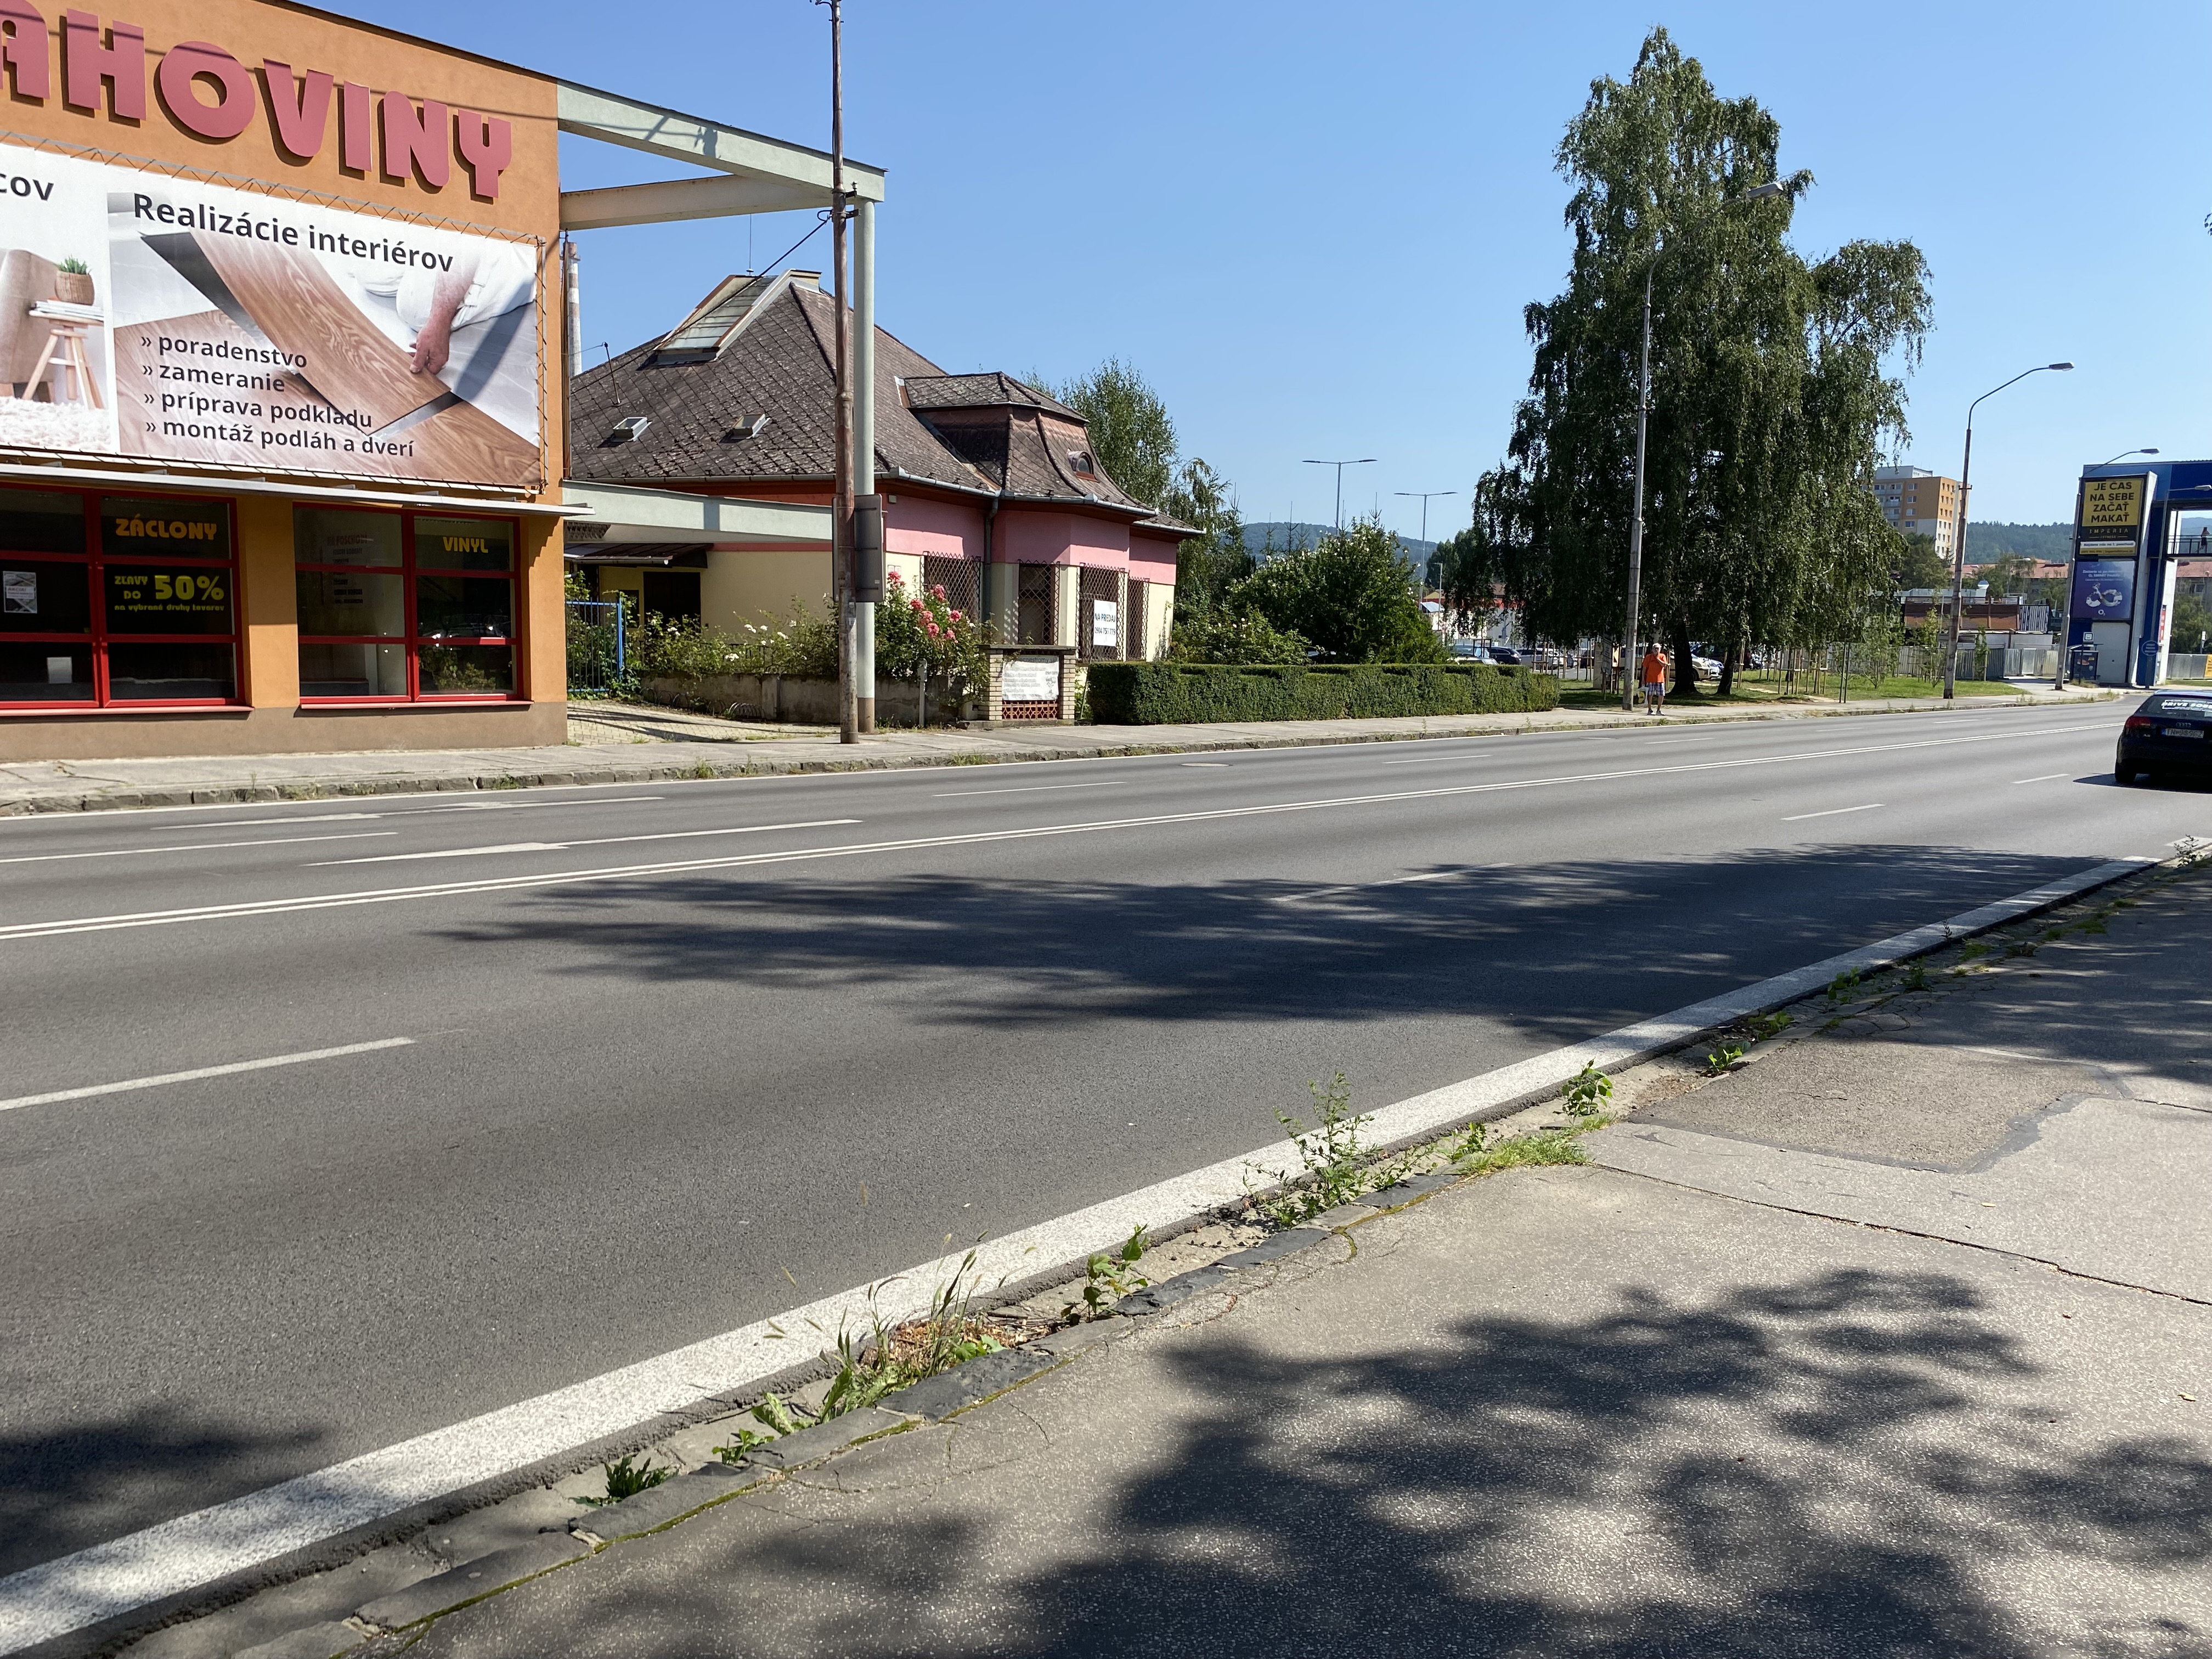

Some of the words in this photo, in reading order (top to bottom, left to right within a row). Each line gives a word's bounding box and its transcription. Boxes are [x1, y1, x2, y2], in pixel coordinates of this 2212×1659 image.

[134, 193, 298, 246] Realizácie
[309, 225, 453, 273] interiérov
[159, 336, 307, 368] poradenstvo
[160, 364, 285, 392] zameranie
[161, 392, 262, 416] príprava
[270, 403, 372, 427] podkladu
[163, 421, 253, 443] montáž
[261, 428, 336, 450] podláh
[343, 441, 355, 453] a
[362, 437, 413, 457] dverí
[2108, 493, 2134, 501] SEBE
[2109, 481, 2132, 490] ČAS
[2091, 512, 2129, 523] MAKAŤ
[2094, 501, 2129, 512] ZAČAŤ
[116, 514, 217, 540] ZÁCLONY
[443, 537, 488, 553] VINYL
[123, 590, 141, 599] DO
[155, 575, 224, 600] 50%
[166, 604, 190, 612] druhy
